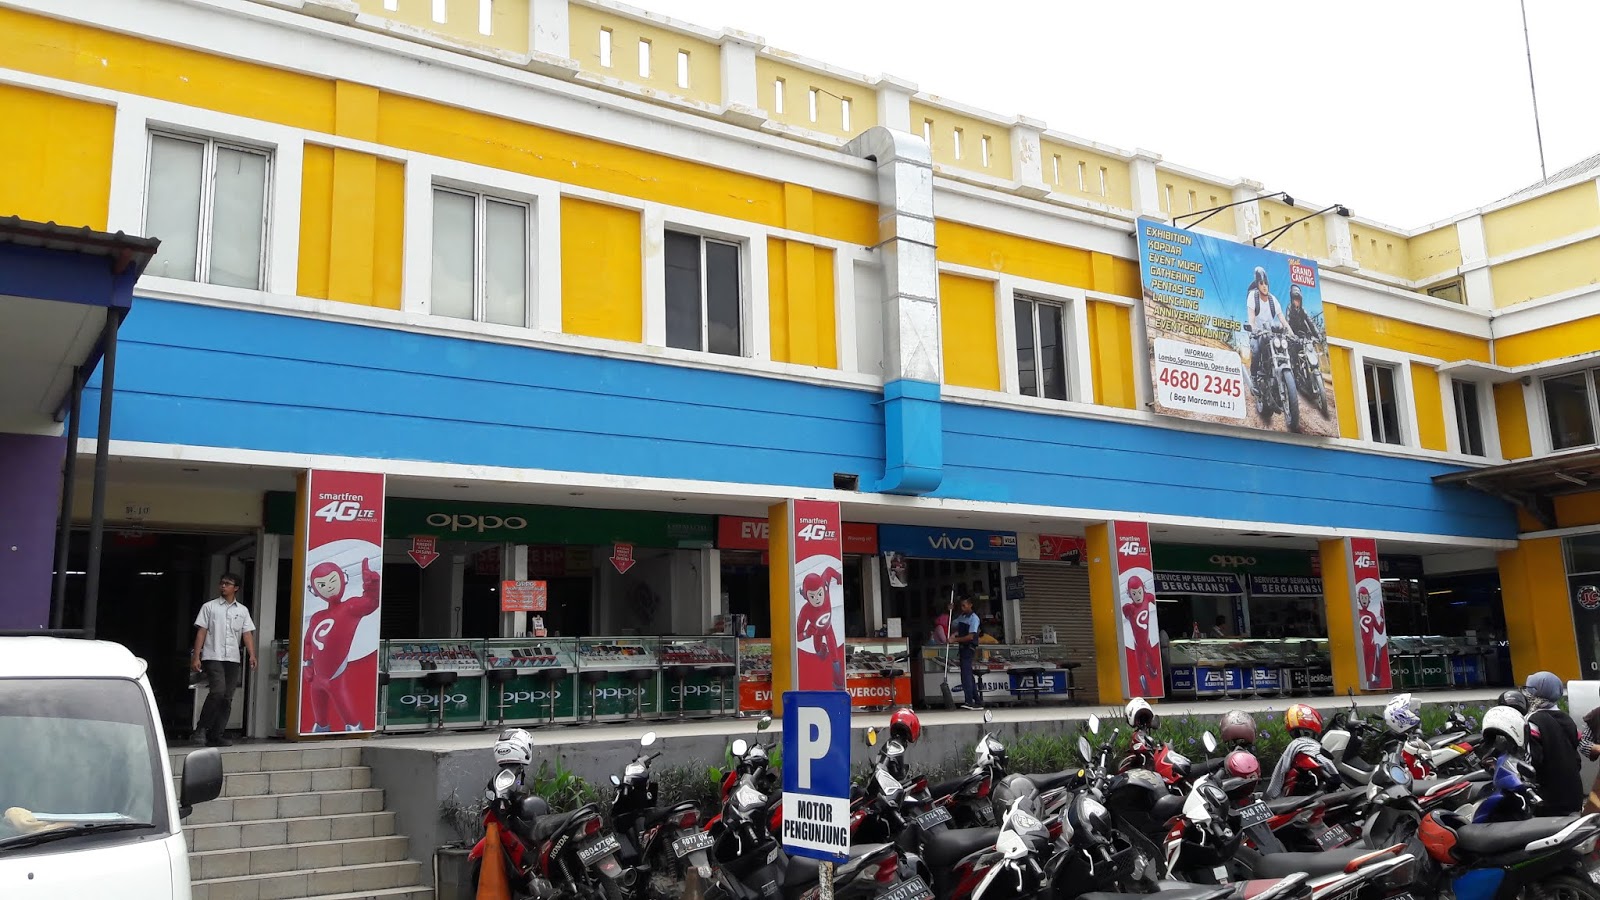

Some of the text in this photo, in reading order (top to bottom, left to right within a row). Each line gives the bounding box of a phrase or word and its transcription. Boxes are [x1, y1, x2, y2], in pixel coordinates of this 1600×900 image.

[1146, 227, 1192, 246] EXHIBITION
[1147, 240, 1182, 256] KOPDAR
[1149, 253, 1203, 273] EVENT MUSIC
[1292, 265, 1312, 277] GRAND
[1150, 266, 1196, 284] GATHERING
[1291, 273, 1315, 286] CAKUNG
[1151, 279, 1204, 299] PENTAS SENI
[1152, 293, 1199, 310] LAUNCHING
[1153, 306, 1241, 331] ANNIVERSARY BIKERS
[1155, 319, 1231, 340] EVENT COMMUNITY
[1184, 348, 1214, 359] INFORMASI
[1211, 363, 1225, 371] Open
[1159, 367, 1241, 397] 4680 2345
[1187, 395, 1219, 407] Marcomm
[319, 492, 363, 501] smartfren
[315, 501, 375, 522] 4G LTE
[426, 513, 527, 532] oppo
[798, 524, 826, 541] 4G
[928, 532, 974, 551] vivo
[1119, 541, 1139, 556] 4G
[1209, 554, 1256, 568] oppo
[1355, 556, 1370, 568] 4G
[1162, 581, 1230, 592] BERGARANSI
[1205, 671, 1234, 682] ASUS
[589, 687, 646, 699] oppo
[671, 684, 722, 696] oppo
[400, 693, 467, 707] oppo
[798, 706, 832, 789] P
[797, 800, 833, 823] MOTOR
[783, 819, 847, 847] PENGUNJUNG
[549, 833, 570, 860] HONDA
